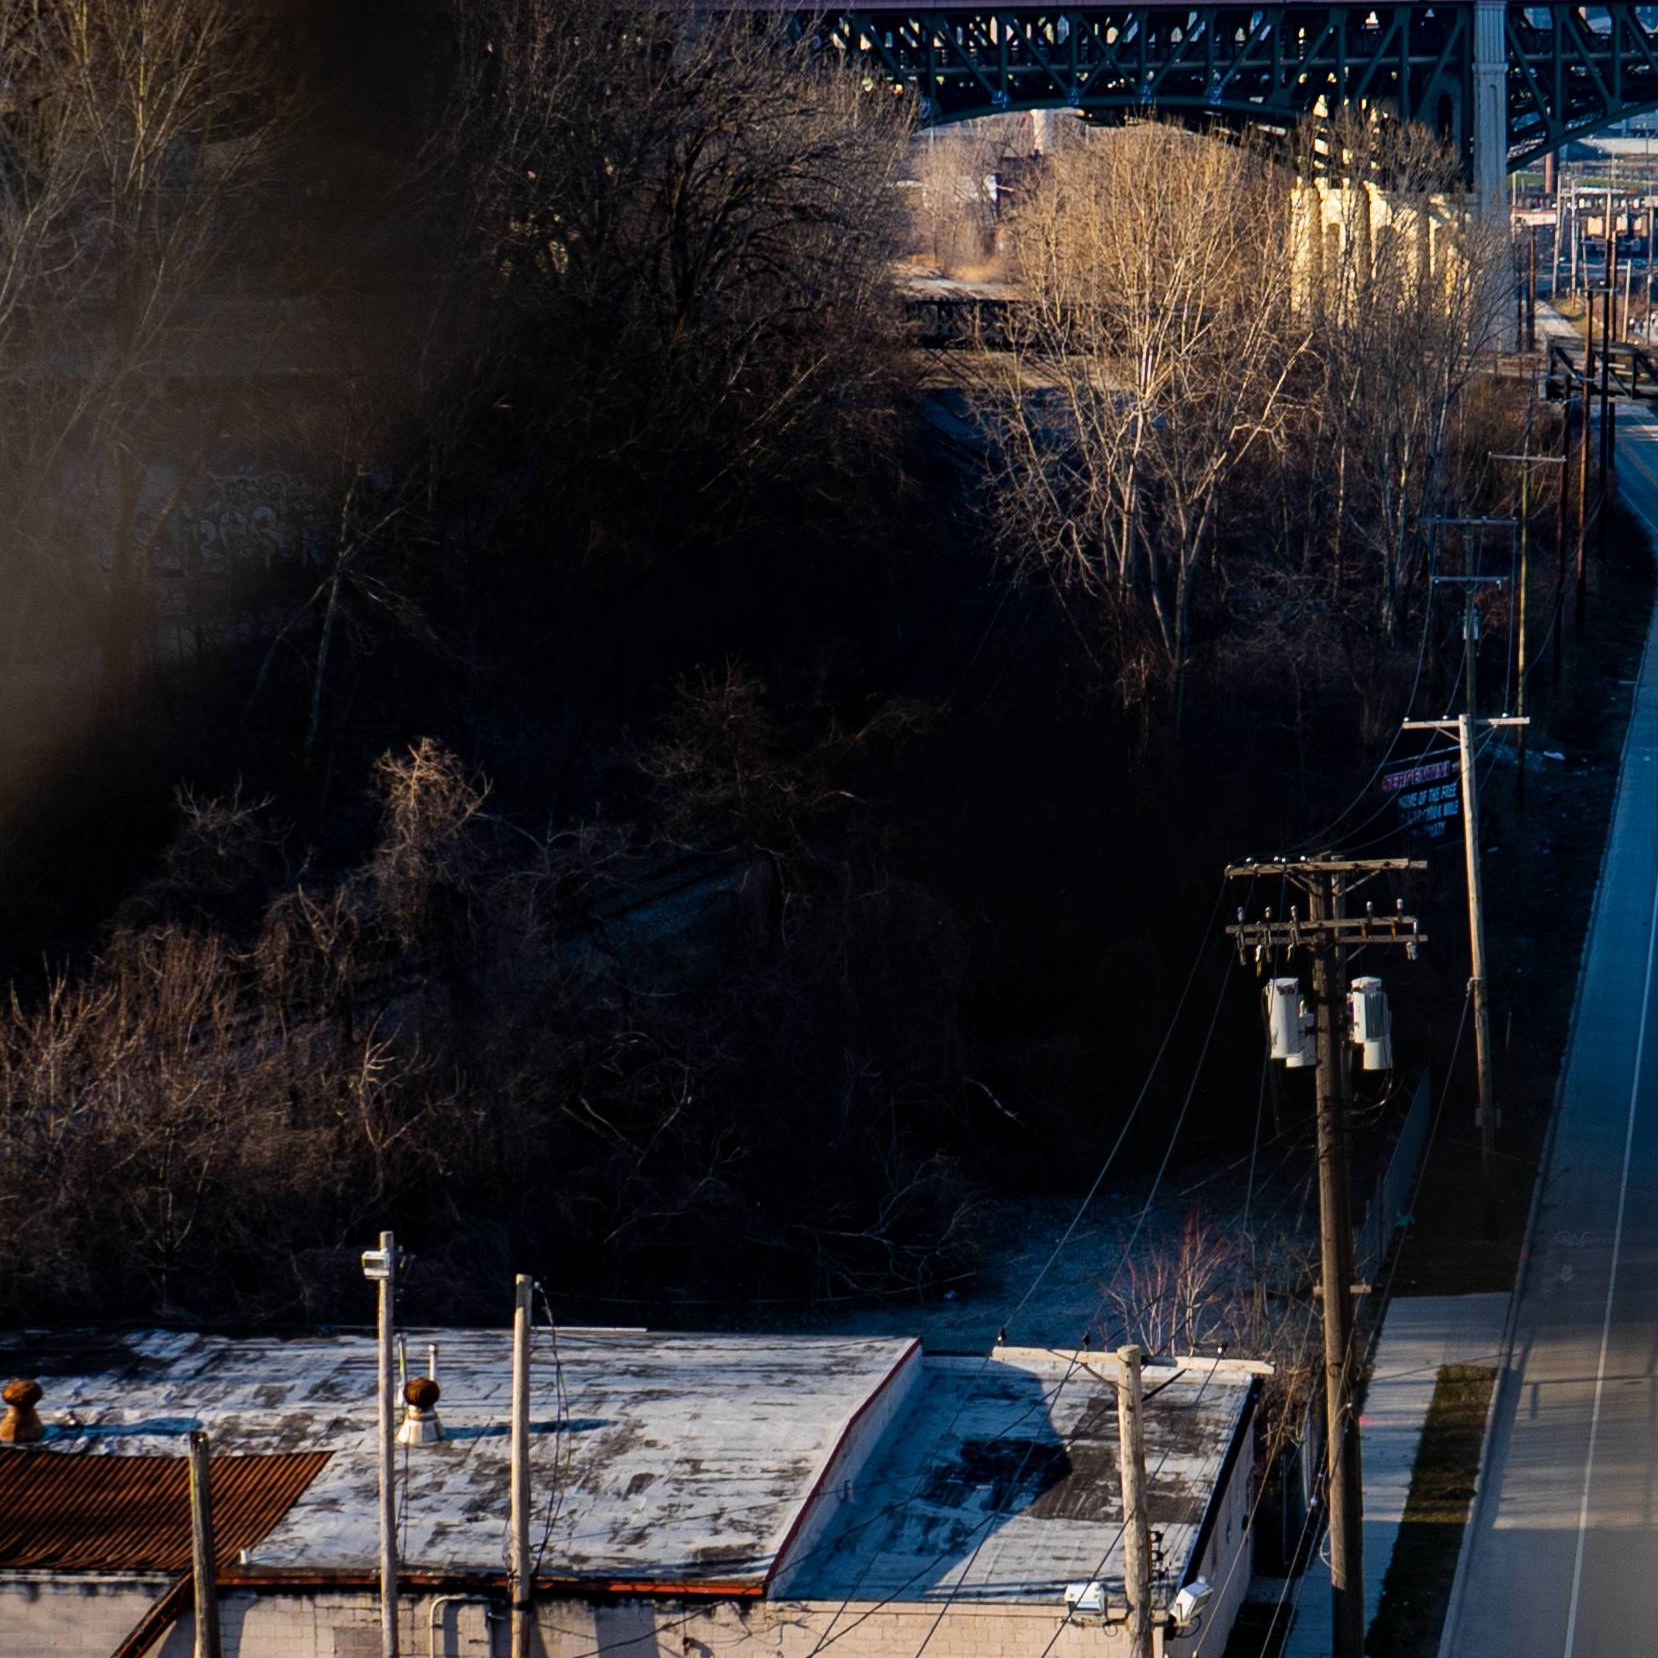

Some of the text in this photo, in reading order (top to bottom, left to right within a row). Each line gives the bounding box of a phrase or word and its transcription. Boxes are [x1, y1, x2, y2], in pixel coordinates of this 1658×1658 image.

[1418, 789, 1428, 806] OF
[1428, 786, 1441, 803] THE
[1441, 782, 1457, 799] FREE
